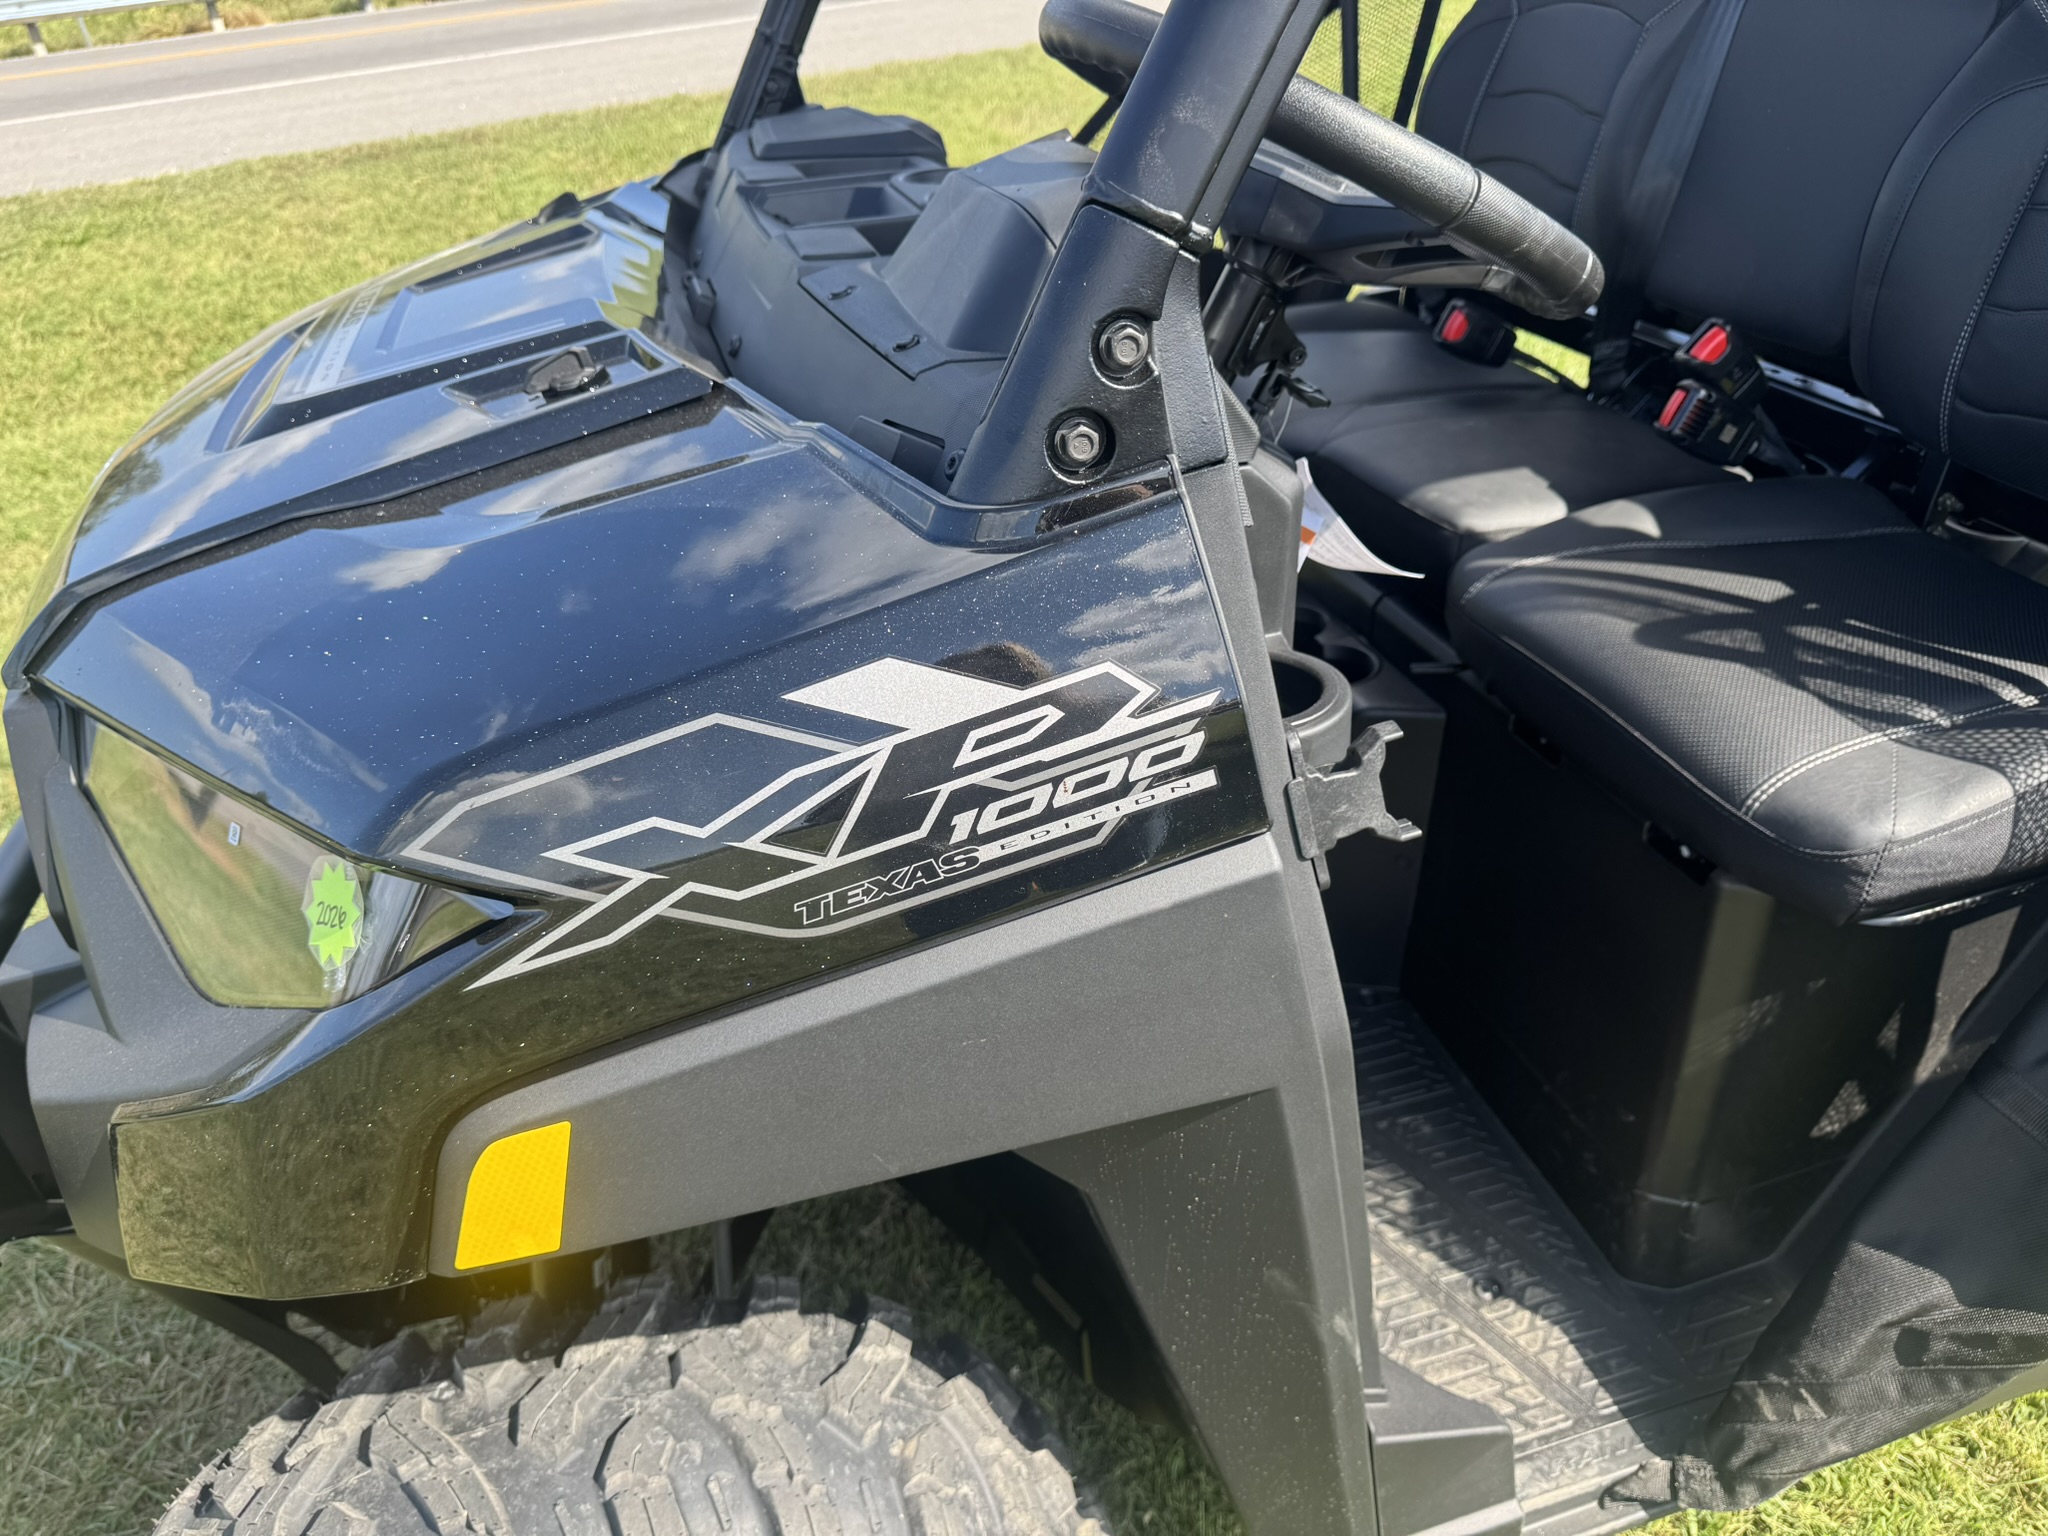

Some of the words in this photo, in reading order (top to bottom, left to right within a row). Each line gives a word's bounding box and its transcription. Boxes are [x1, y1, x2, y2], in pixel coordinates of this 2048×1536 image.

[462, 656, 1222, 992] XP
[949, 730, 1207, 845] 1000
[316, 901, 347, 930] 2026
[794, 846, 984, 925] TEXAS
[999, 782, 1192, 851] EDITION
